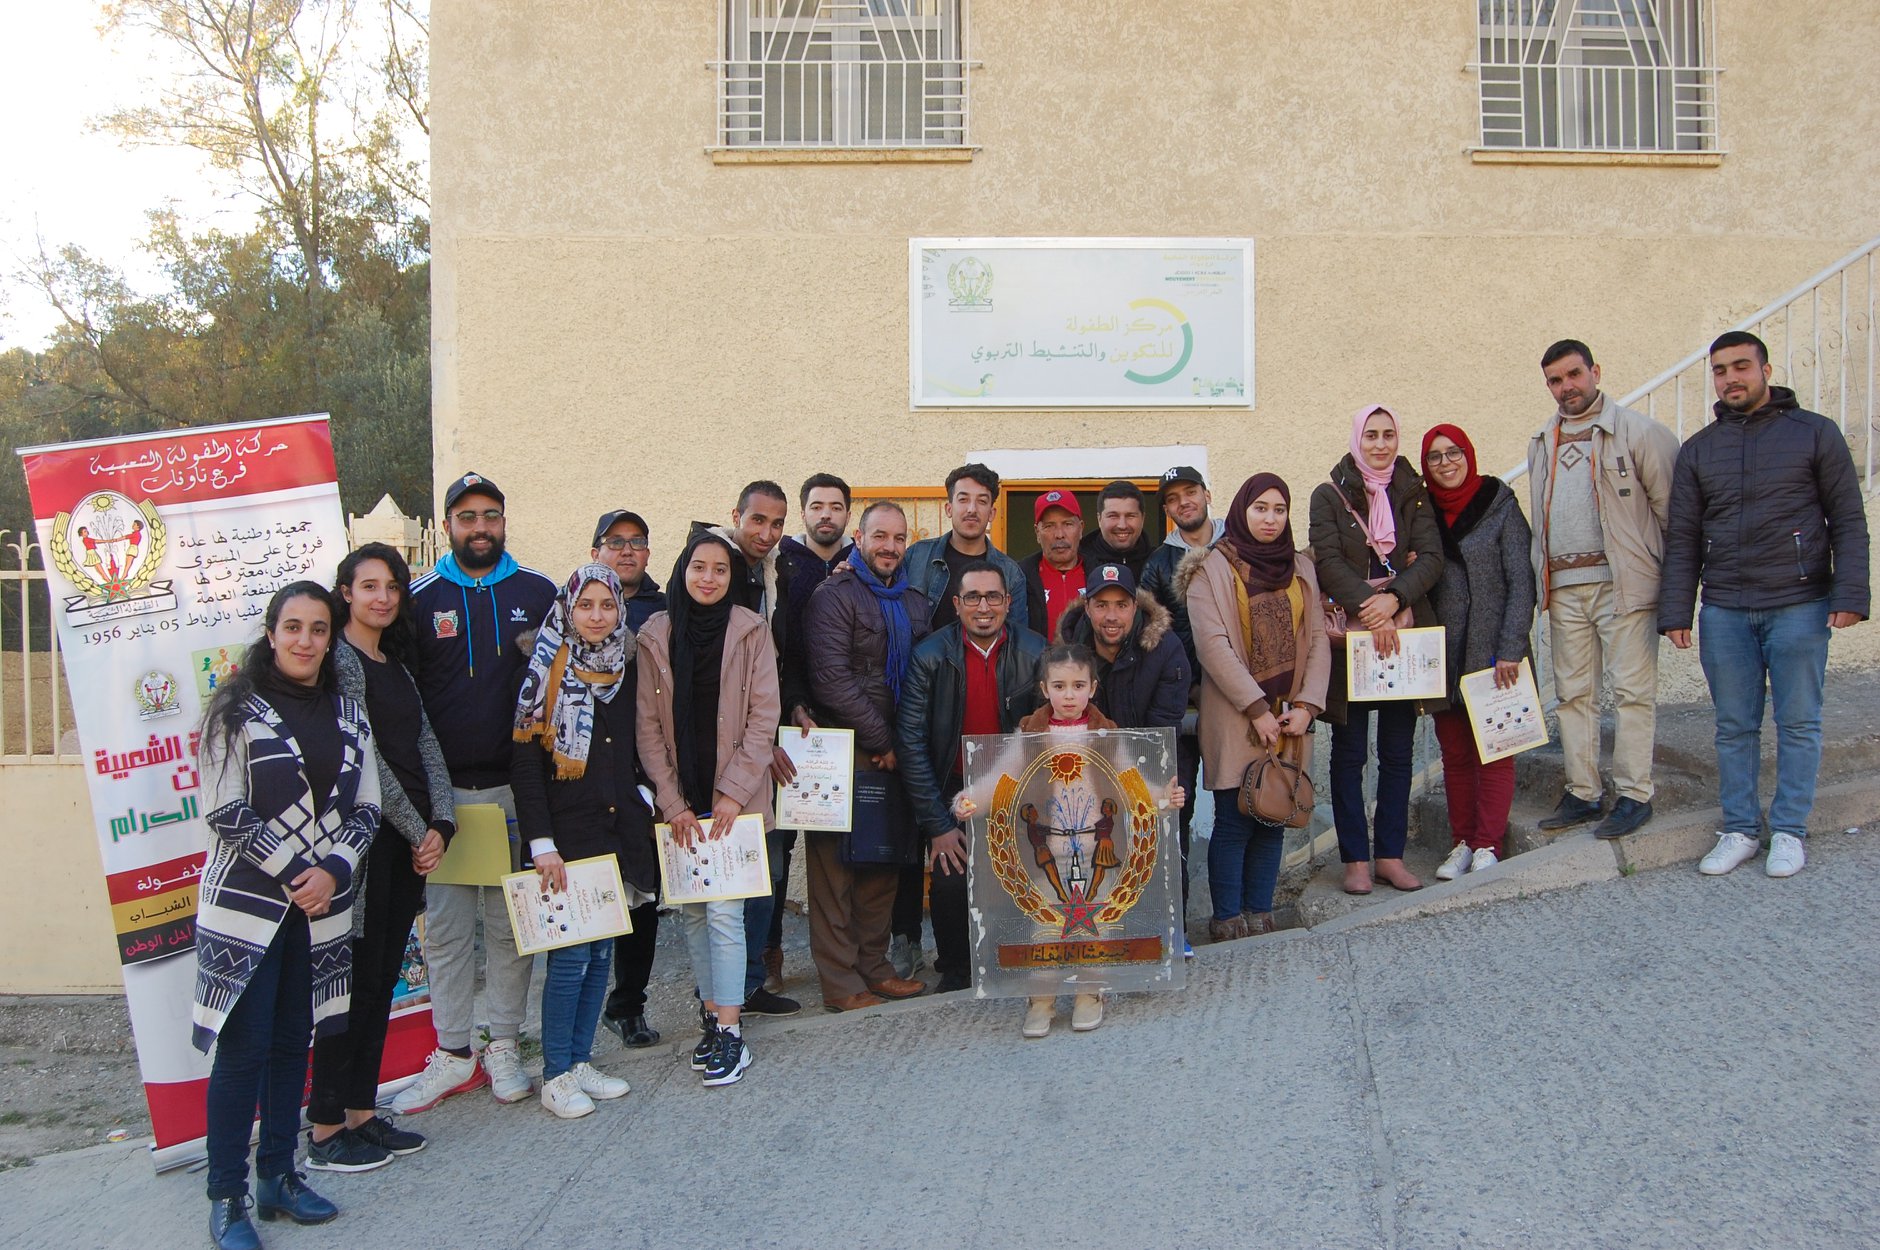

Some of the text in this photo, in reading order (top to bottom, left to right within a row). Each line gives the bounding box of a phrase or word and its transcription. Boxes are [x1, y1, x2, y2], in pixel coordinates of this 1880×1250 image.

[1064, 315, 1174, 337] مركز الطفولة
[970, 339, 1175, 364] للتكوين والتنشيط التربوي
[235, 430, 289, 457] حركة
[90, 449, 163, 476] الشعبية
[140, 460, 247, 493] فرع تاونات
[179, 520, 312, 548] جمعية وطنية لها عدة
[175, 536, 323, 569] فروع على المستوى
[196, 589, 237, 604] العامة
[82, 604, 263, 645] طنيا بالرباط 05 يناير 1956
[94, 734, 183, 780] الشعبية
[110, 795, 199, 842] الكرام
[137, 863, 203, 891] طفولة
[129, 896, 191, 923] الشباب
[126, 934, 163, 957] الوطن
